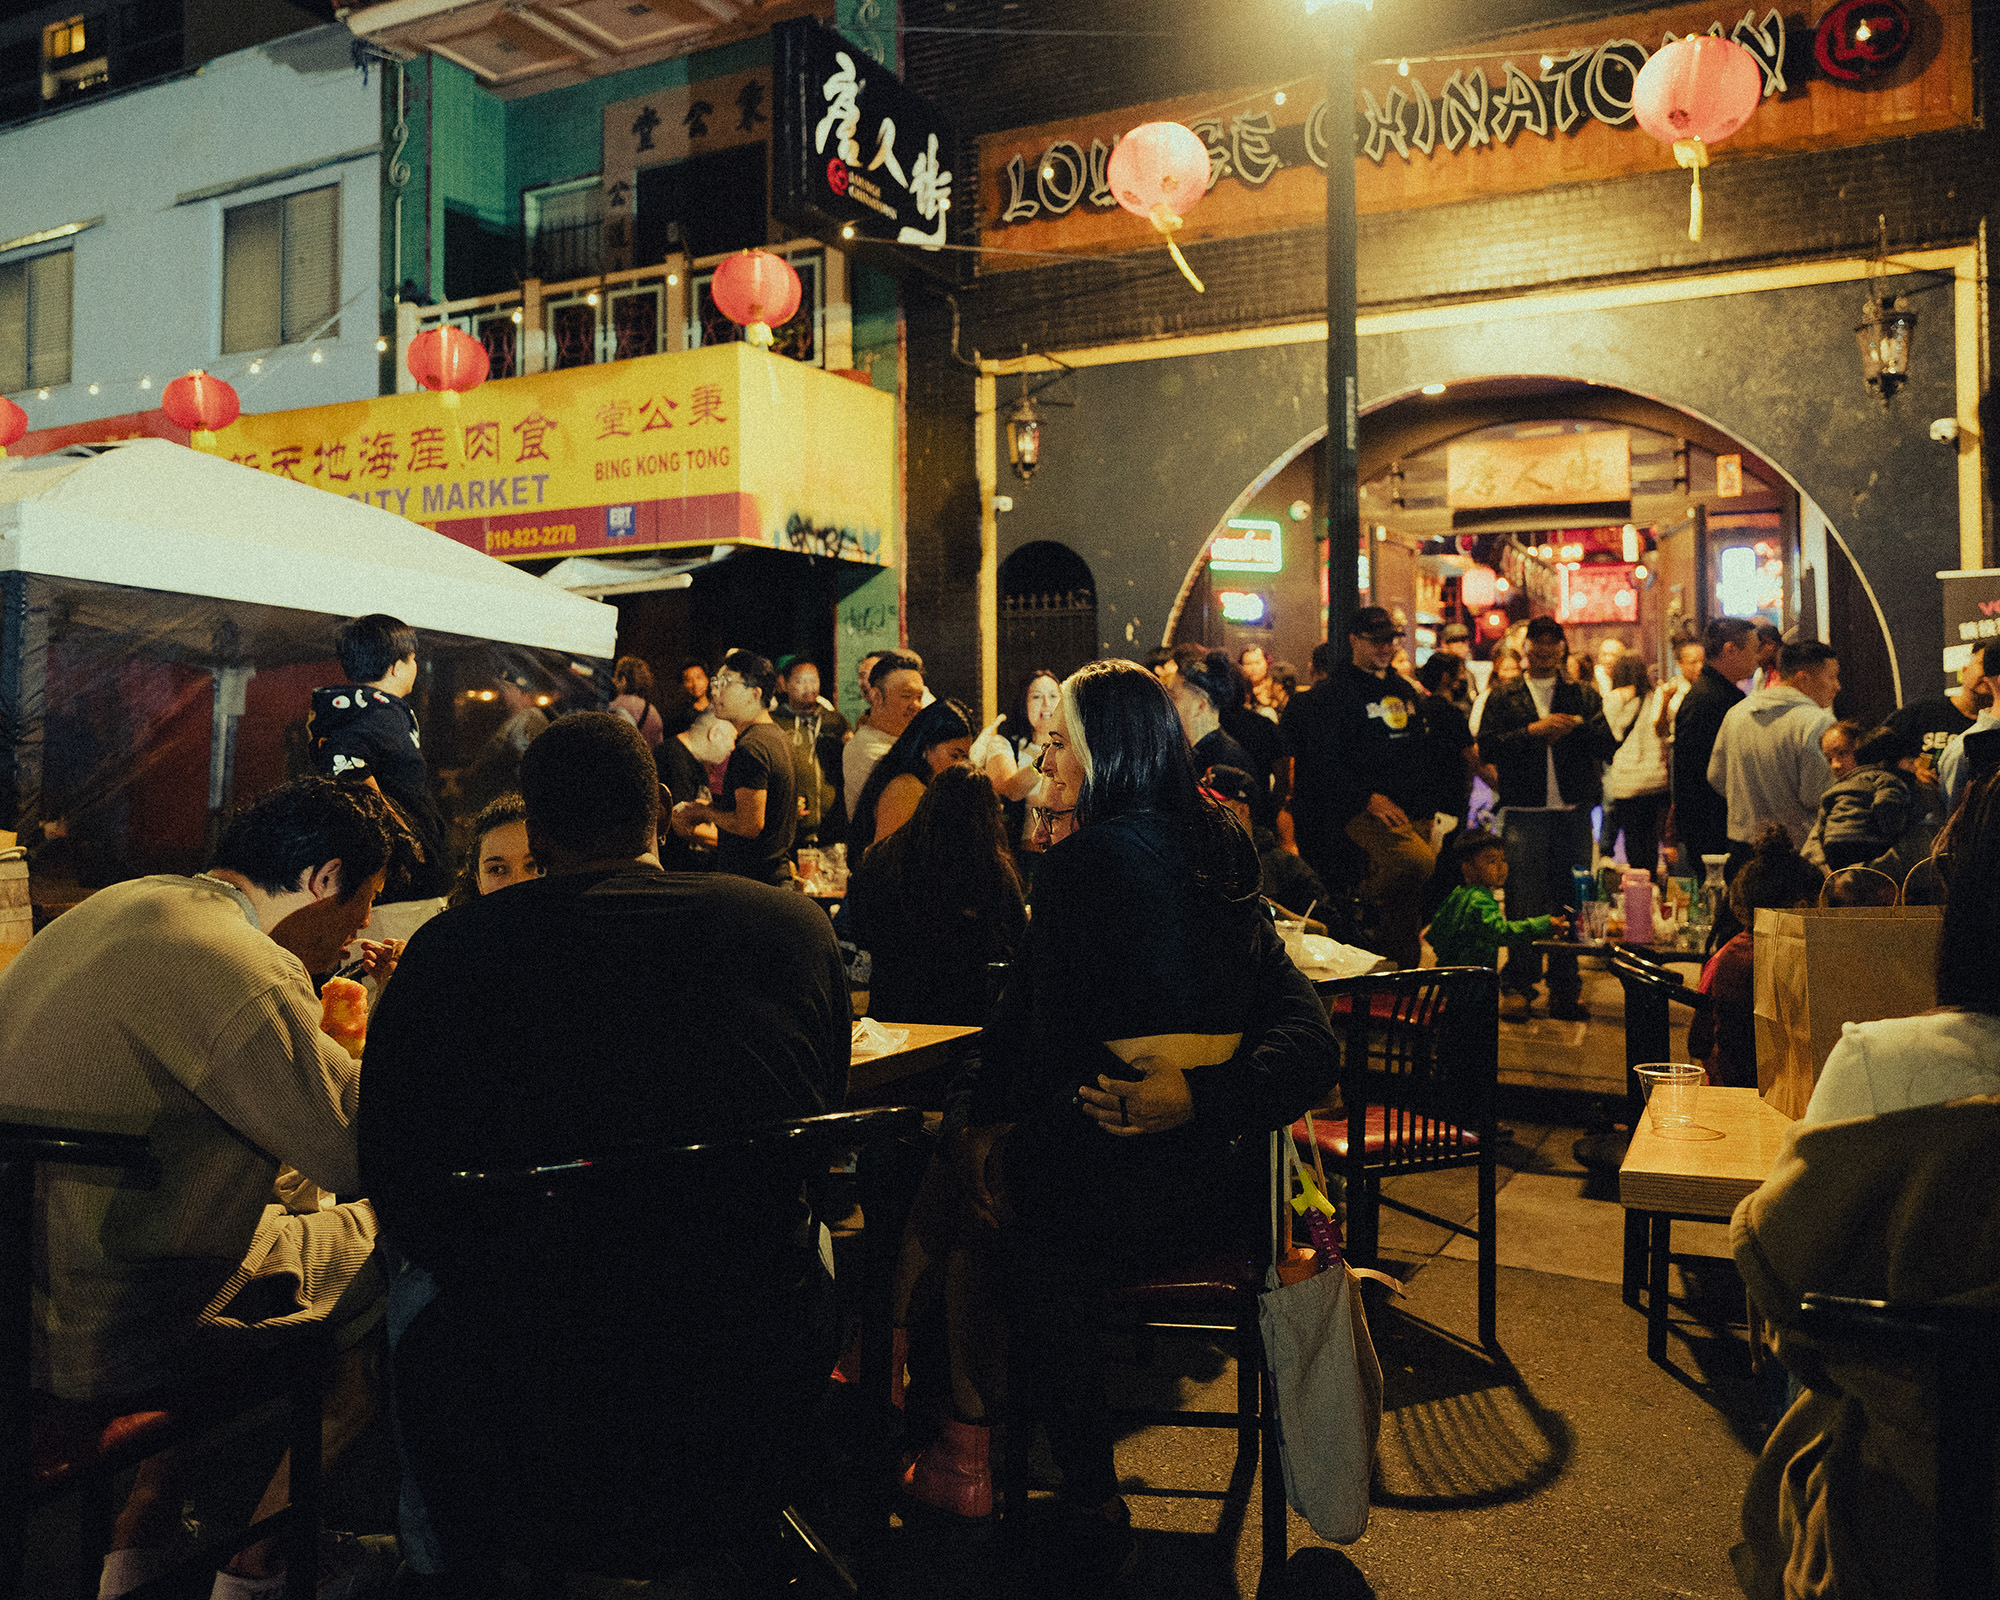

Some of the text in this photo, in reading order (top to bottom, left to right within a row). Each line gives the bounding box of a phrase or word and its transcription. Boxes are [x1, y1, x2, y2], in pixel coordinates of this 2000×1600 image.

[1304, 7, 1788, 168] CHINATON
[595, 446, 730, 482] BING KONG TONG
[421, 474, 550, 514] MARKET
[608, 506, 633, 529] EBT
